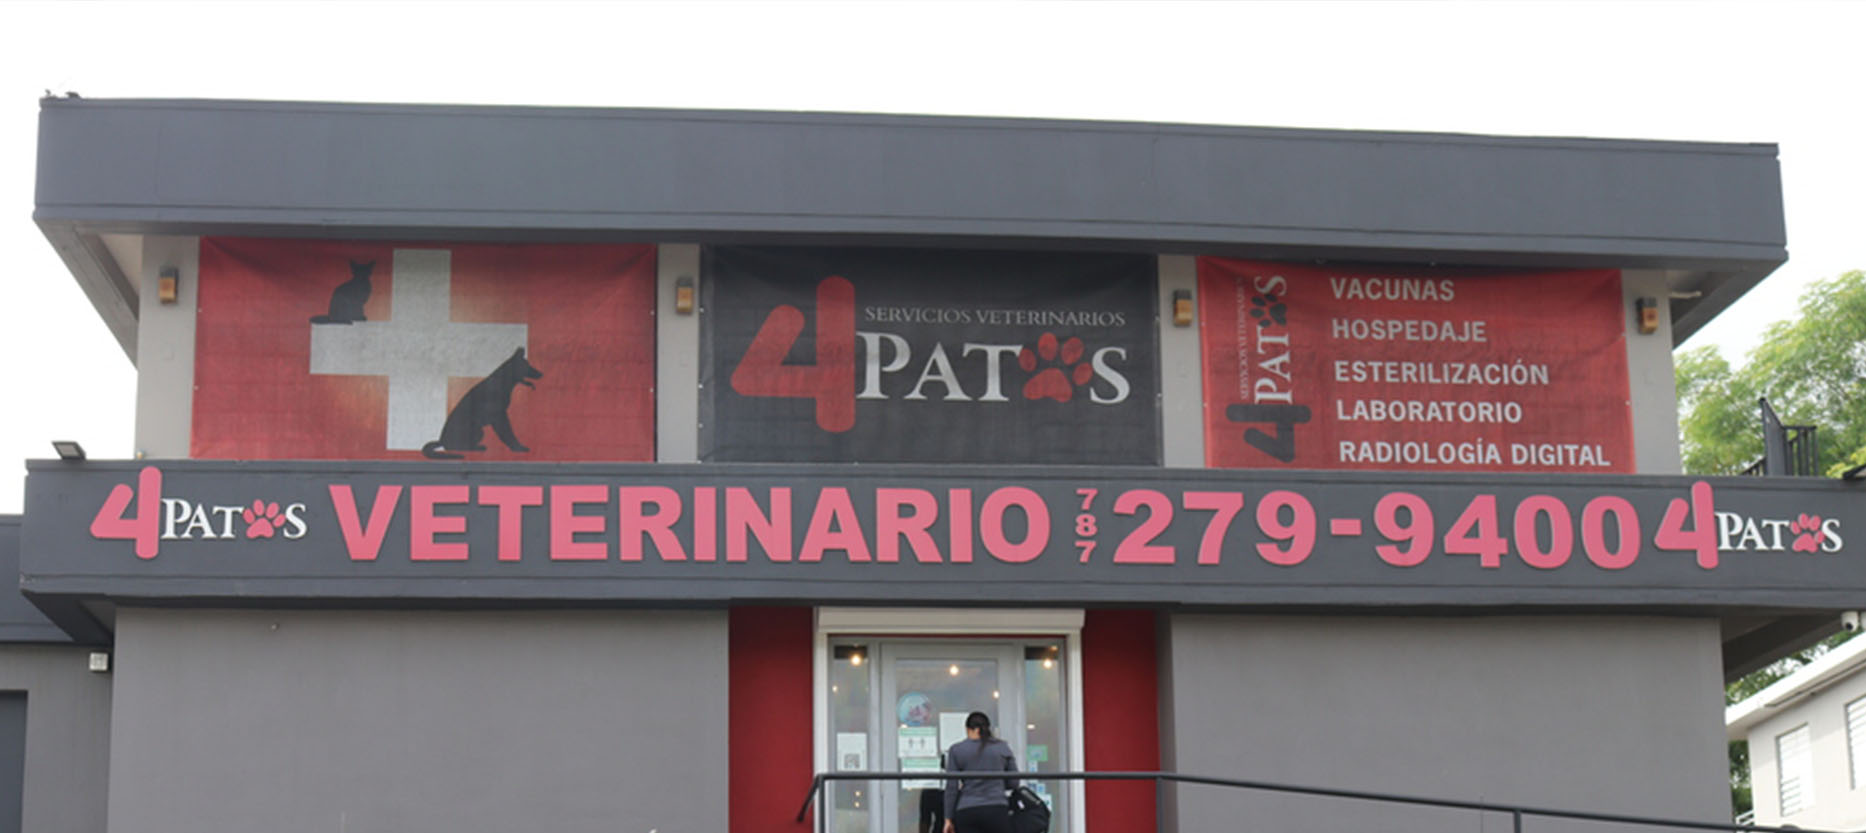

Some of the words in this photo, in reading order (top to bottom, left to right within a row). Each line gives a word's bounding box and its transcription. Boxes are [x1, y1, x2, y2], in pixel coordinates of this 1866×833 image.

[1330, 278, 1455, 301] VACUNAS
[865, 305, 971, 324] SERVICIOS
[975, 309, 1126, 327] VETERINARIOS
[1332, 319, 1487, 342] HOSPEDAJE
[1334, 359, 1550, 385] ESTERILIZACIÓN
[1337, 400, 1522, 423] LABORATORIO
[1339, 439, 1502, 465] RADIOLOGÍA
[1511, 444, 1611, 466] DIGITAL
[328, 485, 1051, 562] VETERINARIO
[1112, 488, 1641, 570] 279-9400
